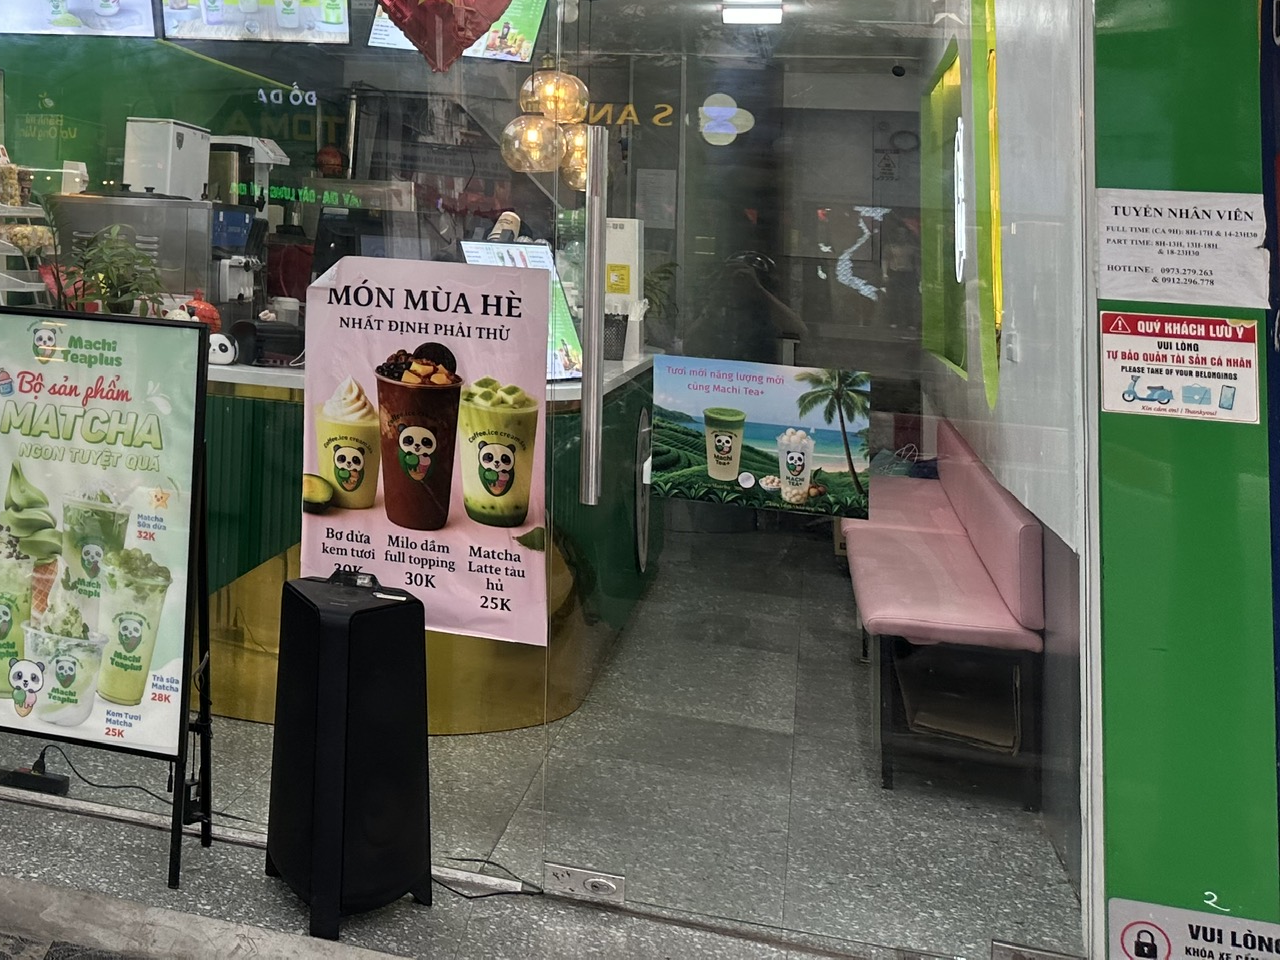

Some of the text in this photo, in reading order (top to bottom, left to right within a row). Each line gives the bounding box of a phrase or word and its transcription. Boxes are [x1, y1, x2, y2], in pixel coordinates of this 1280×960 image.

[1111, 204, 1254, 222] TUYỂN NHÂN VIÊN
[1107, 264, 1213, 277] HOTLINE: 0973.279.263
[1161, 277, 1215, 287] 0912.296.778
[327, 279, 522, 318] MÓN MÙA HÈ
[339, 315, 511, 341] NHẤT ĐỊNH PHẢI THỬ
[1137, 319, 1160, 334] QUÝ
[1165, 320, 1205, 336] KHÁCH
[68, 335, 118, 352] Machi
[1157, 341, 1199, 352] VUI LÒNG
[61, 349, 123, 368] Teaplus
[1106, 349, 1252, 368] TỰ BẢO QUẢN TÀI SẢN CÁ NHÂN
[666, 366, 686, 375] Tươi
[689, 368, 707, 377] mới
[736, 372, 763, 385] lượng
[766, 375, 784, 385] mới
[17, 371, 132, 407] Bộ sản phẩm
[687, 382, 764, 396] cùng Machi Tea+
[0, 399, 164, 451] MATCHA
[18, 442, 66, 461] NGON
[69, 446, 122, 471] TUYỆT
[137, 530, 156, 541] 32K
[387, 535, 418, 550] Milo
[384, 550, 456, 572] full topping
[469, 545, 522, 563] Matcha
[468, 560, 502, 575] Latte
[404, 572, 436, 589] 30K
[479, 595, 512, 612] 25K
[151, 692, 172, 704] 28K
[105, 727, 125, 738] 25K
[1203, 891, 1231, 912] 2
[1188, 924, 1223, 944] VUI
[1185, 946, 1214, 960] KHÓA
